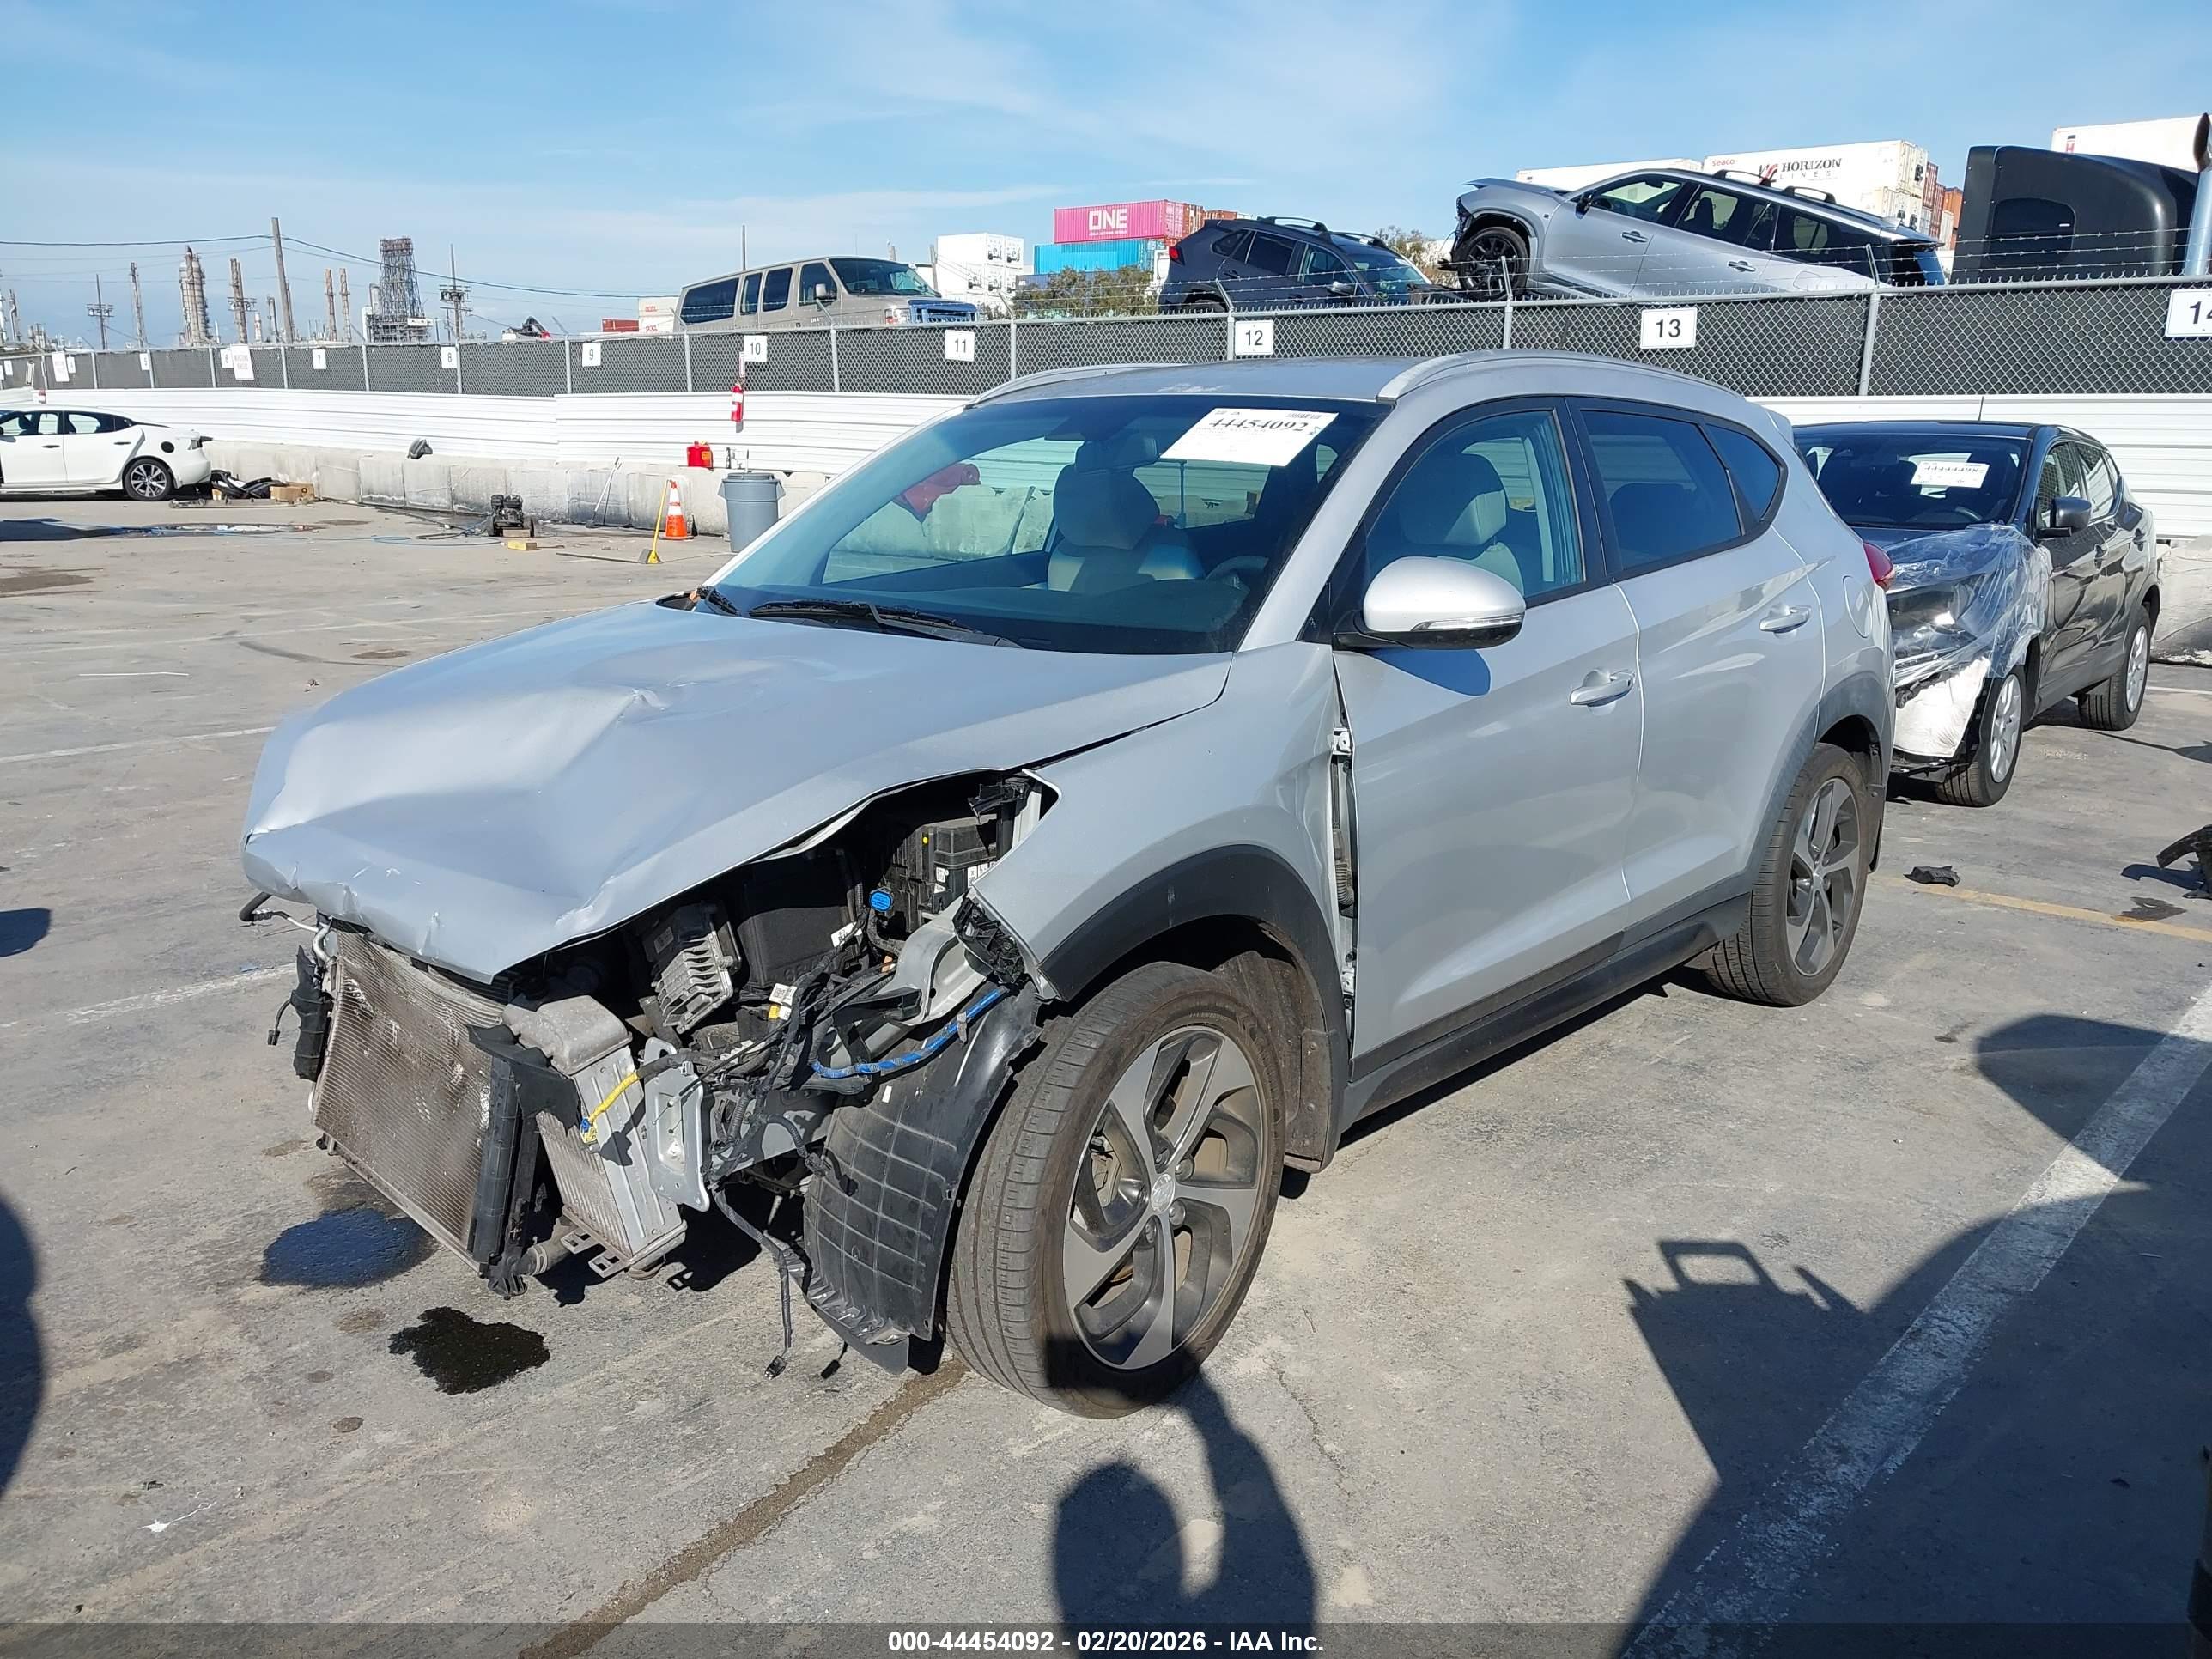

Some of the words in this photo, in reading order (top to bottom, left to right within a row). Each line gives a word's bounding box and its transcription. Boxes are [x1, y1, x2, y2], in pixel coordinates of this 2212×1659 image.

[1712, 158, 1735, 167] seaco
[1781, 158, 1842, 172] HORIZON
[1088, 208, 1127, 230] ONE
[1655, 319, 1681, 338] 13
[1245, 329, 1263, 346] 12
[750, 342, 761, 355] 10
[954, 337, 967, 354] 11
[447, 352, 453, 363] 8
[589, 349, 594, 360] 9
[1208, 417, 1309, 432] 44454092
